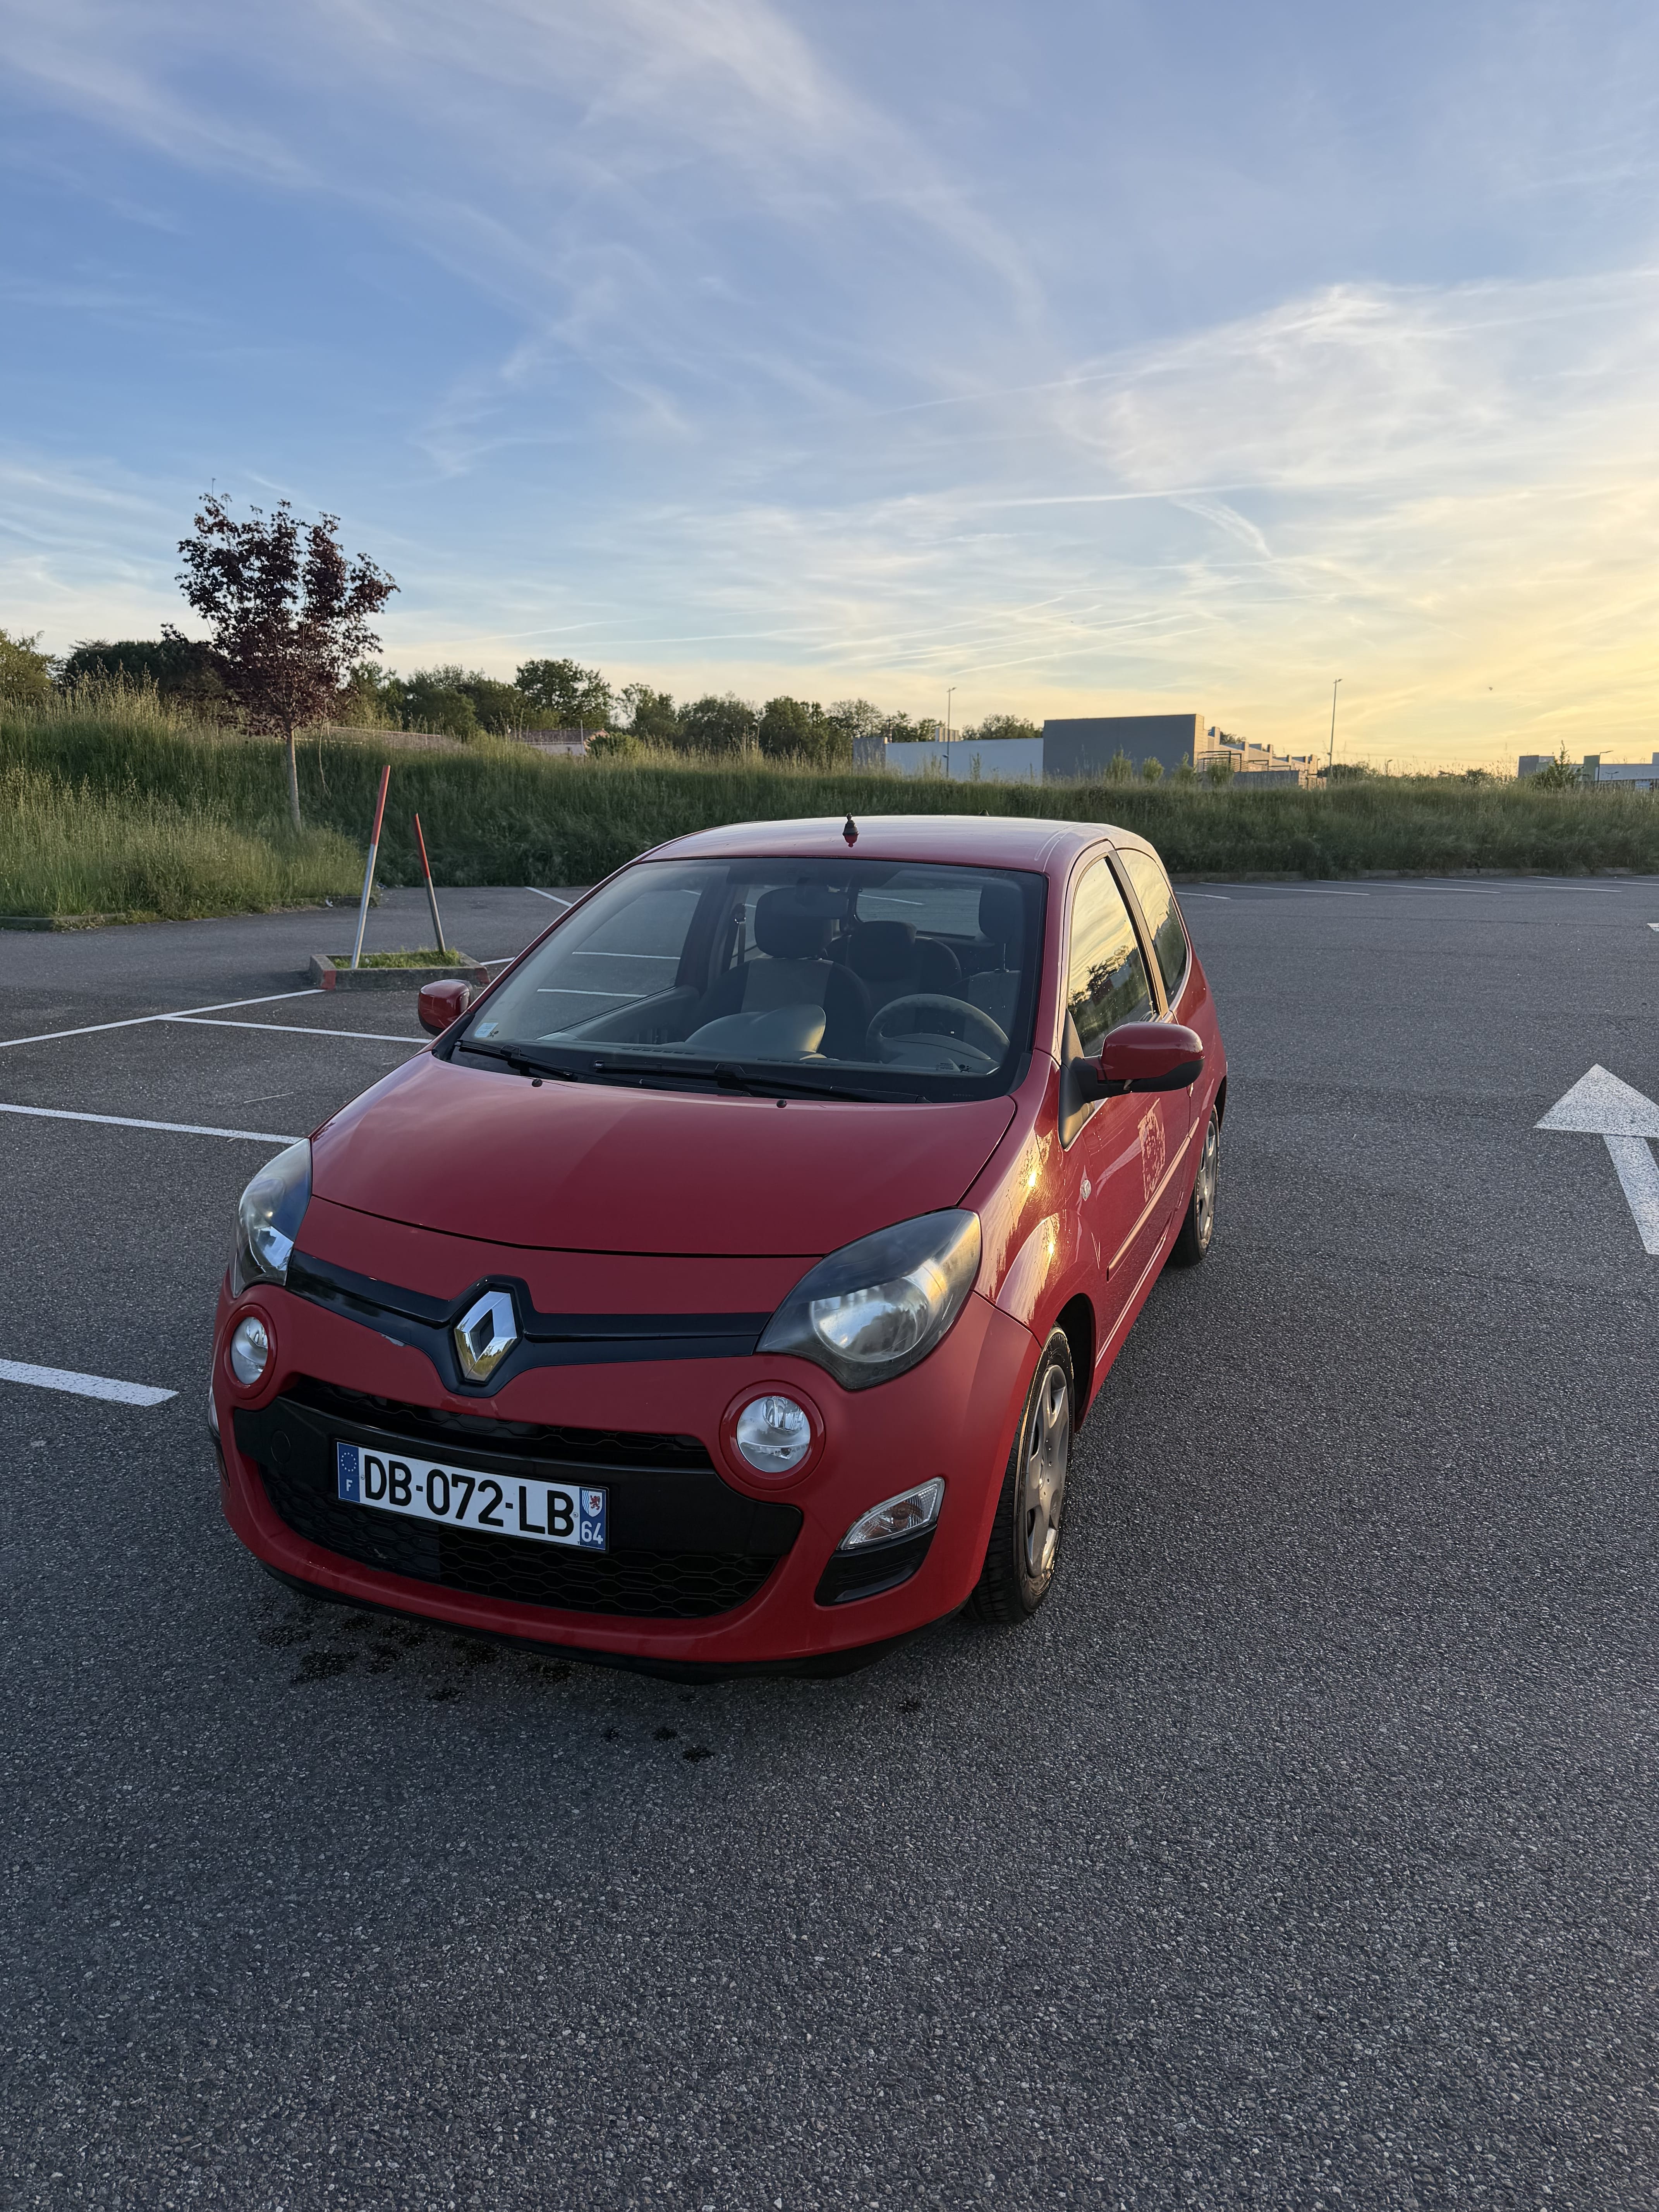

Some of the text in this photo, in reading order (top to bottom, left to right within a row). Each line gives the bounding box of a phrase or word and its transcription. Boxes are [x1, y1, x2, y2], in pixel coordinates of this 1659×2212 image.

[346, 1479, 353, 1491] F
[364, 1455, 574, 1537] DB-072-LB
[581, 1521, 603, 1544] 64
